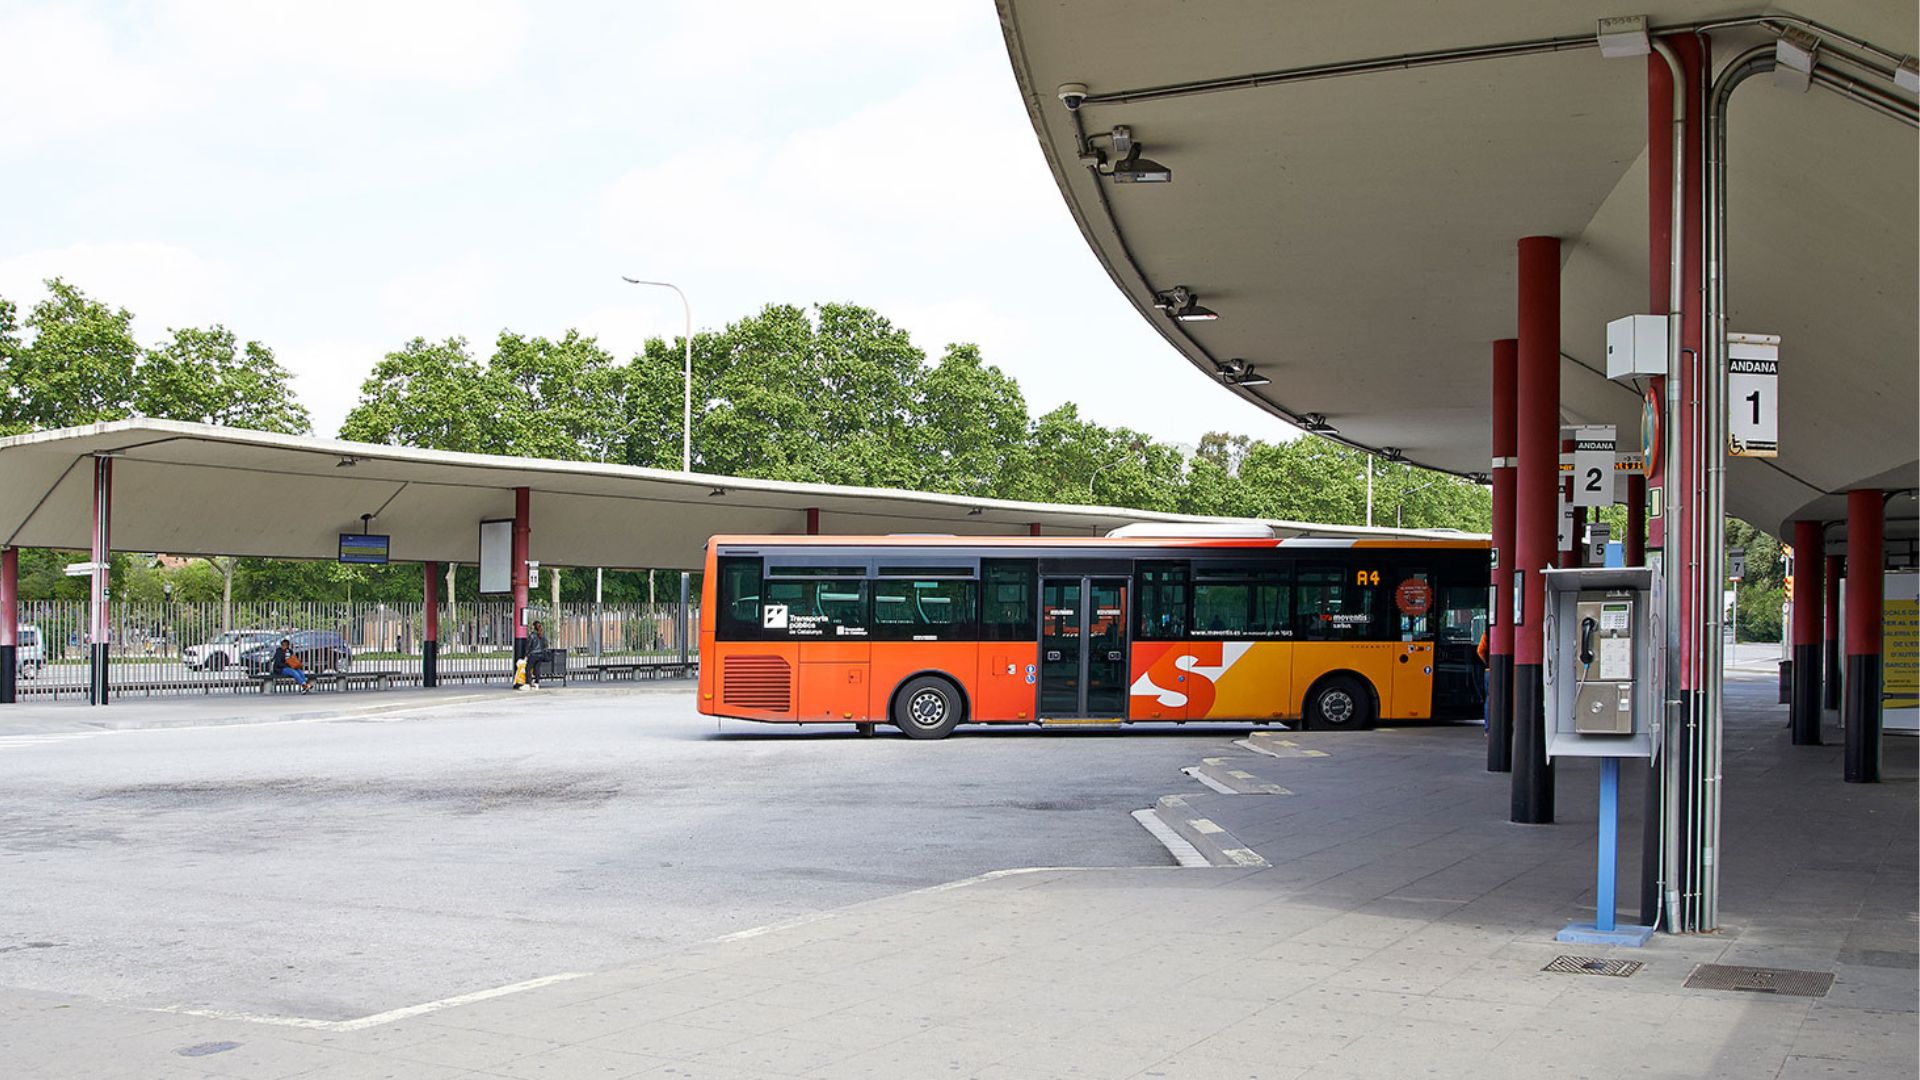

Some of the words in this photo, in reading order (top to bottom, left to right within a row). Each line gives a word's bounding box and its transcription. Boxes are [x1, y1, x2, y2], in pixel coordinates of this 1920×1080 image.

[1730, 361, 1777, 373] ANDANA
[1746, 390, 1760, 425] 1
[1578, 442, 1613, 450] ANDANA
[1585, 467, 1603, 491] 2
[1596, 543, 1605, 556] 5
[1734, 562, 1741, 572] 7
[1357, 570, 1380, 586] A4
[1333, 613, 1367, 621] moventis
